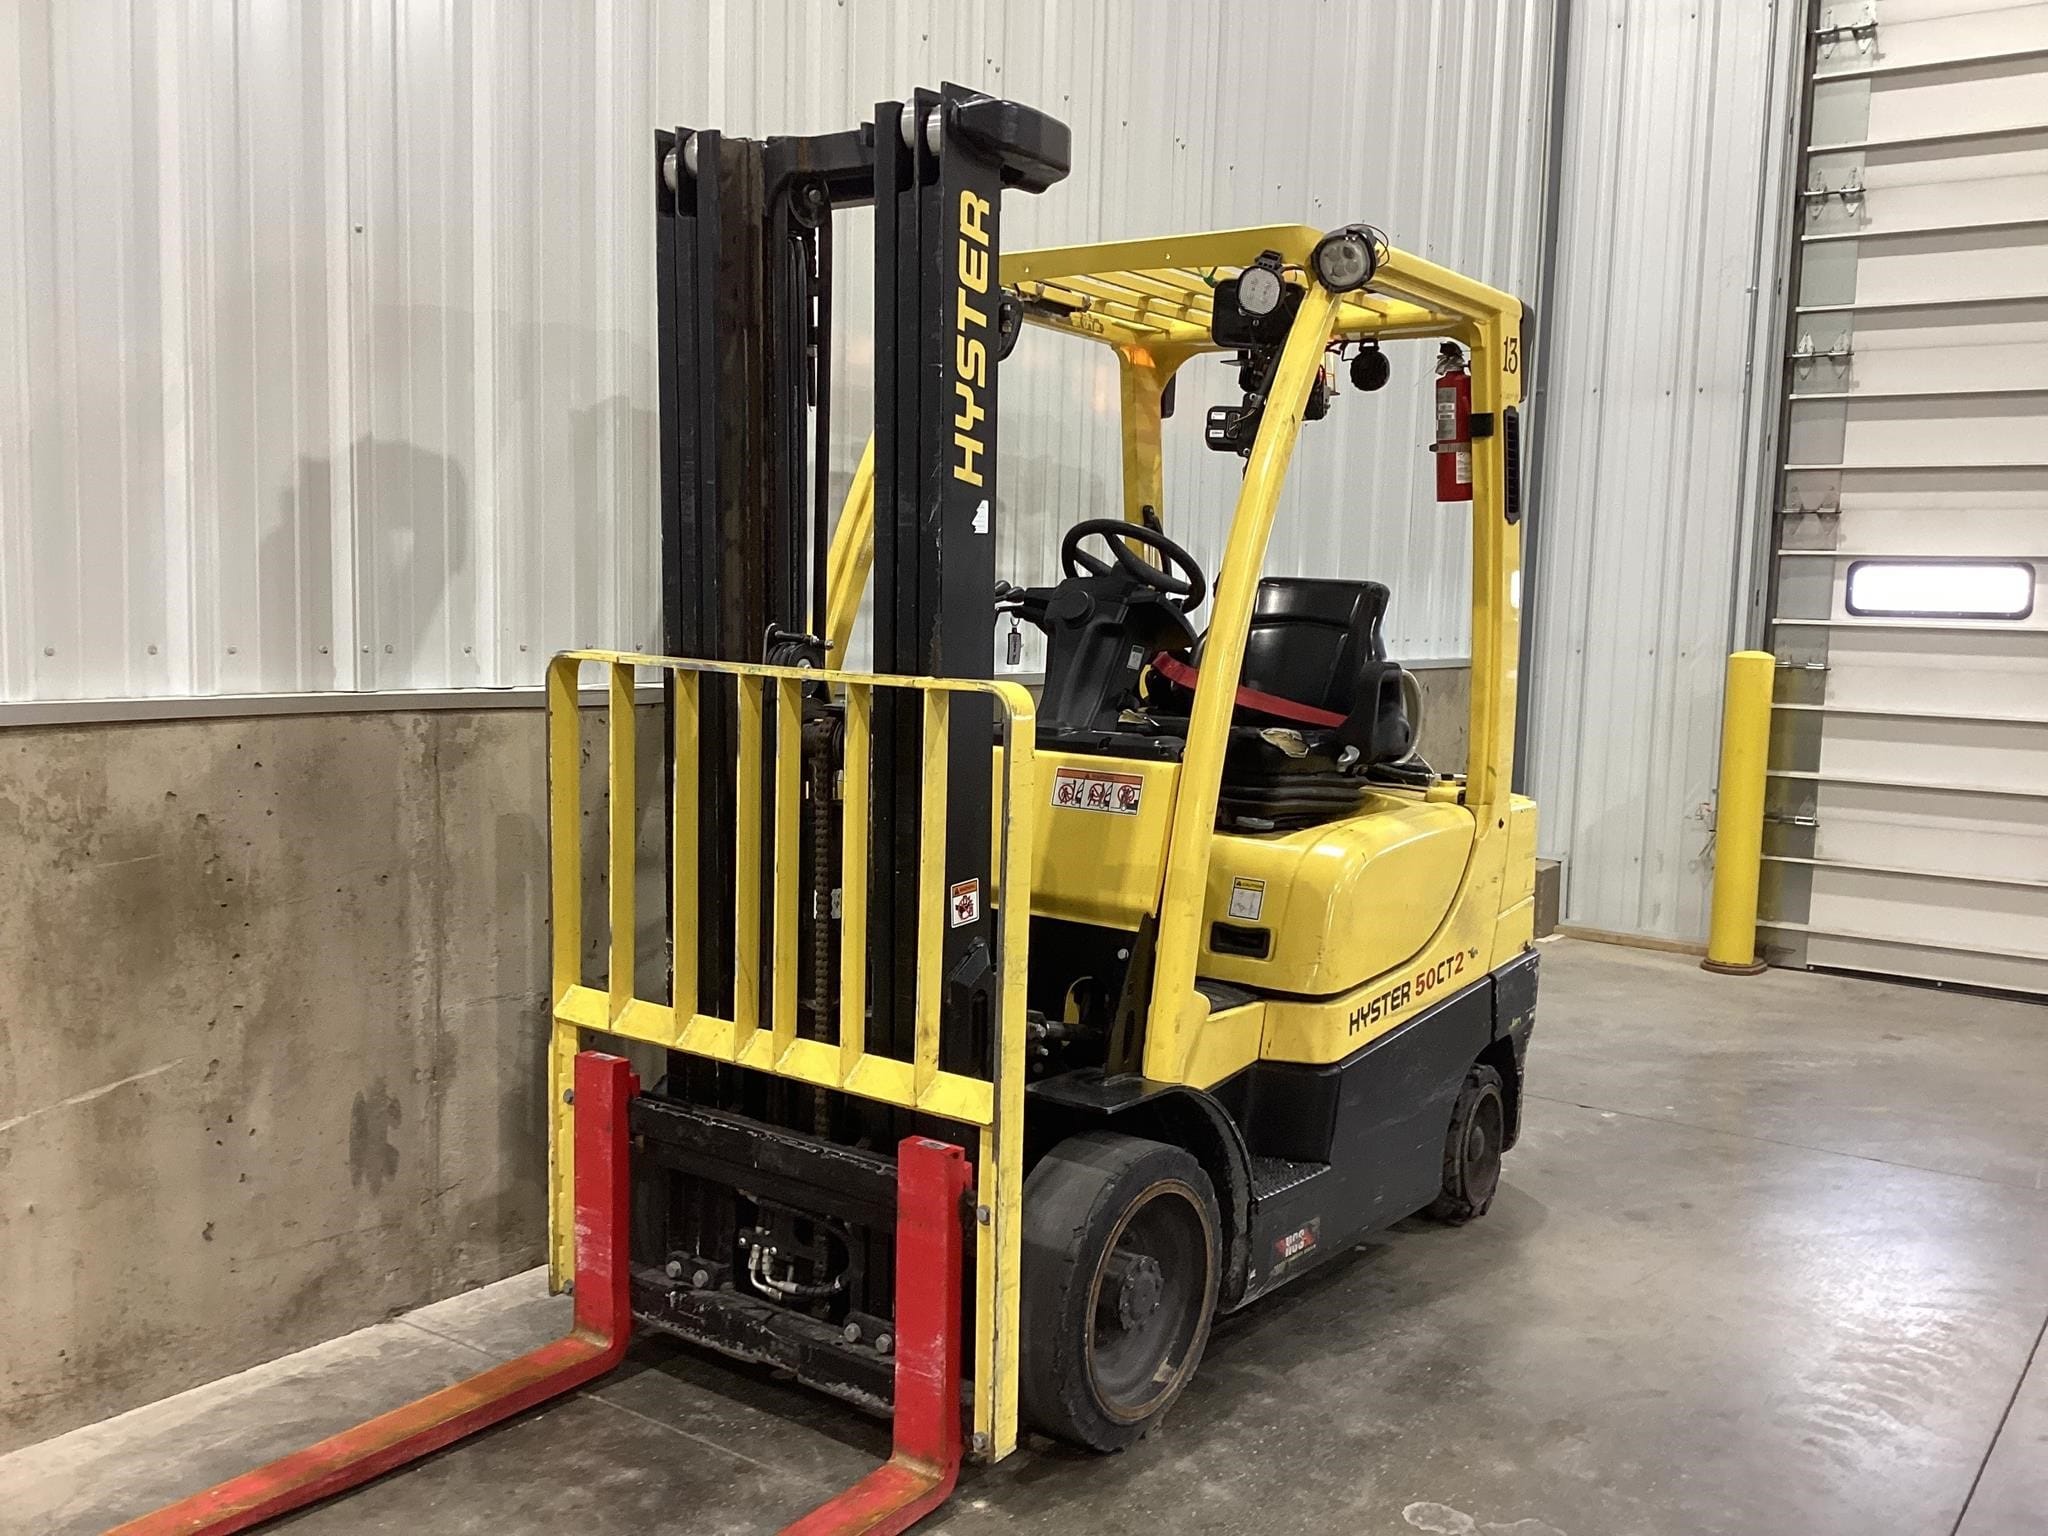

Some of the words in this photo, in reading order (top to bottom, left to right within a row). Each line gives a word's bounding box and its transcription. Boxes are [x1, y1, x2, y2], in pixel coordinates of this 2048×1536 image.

[952, 189, 990, 488] HYSTER
[1503, 336, 1518, 374] 13
[1349, 981, 1411, 1036] HYSTER
[1415, 951, 1464, 997] 50CT2
